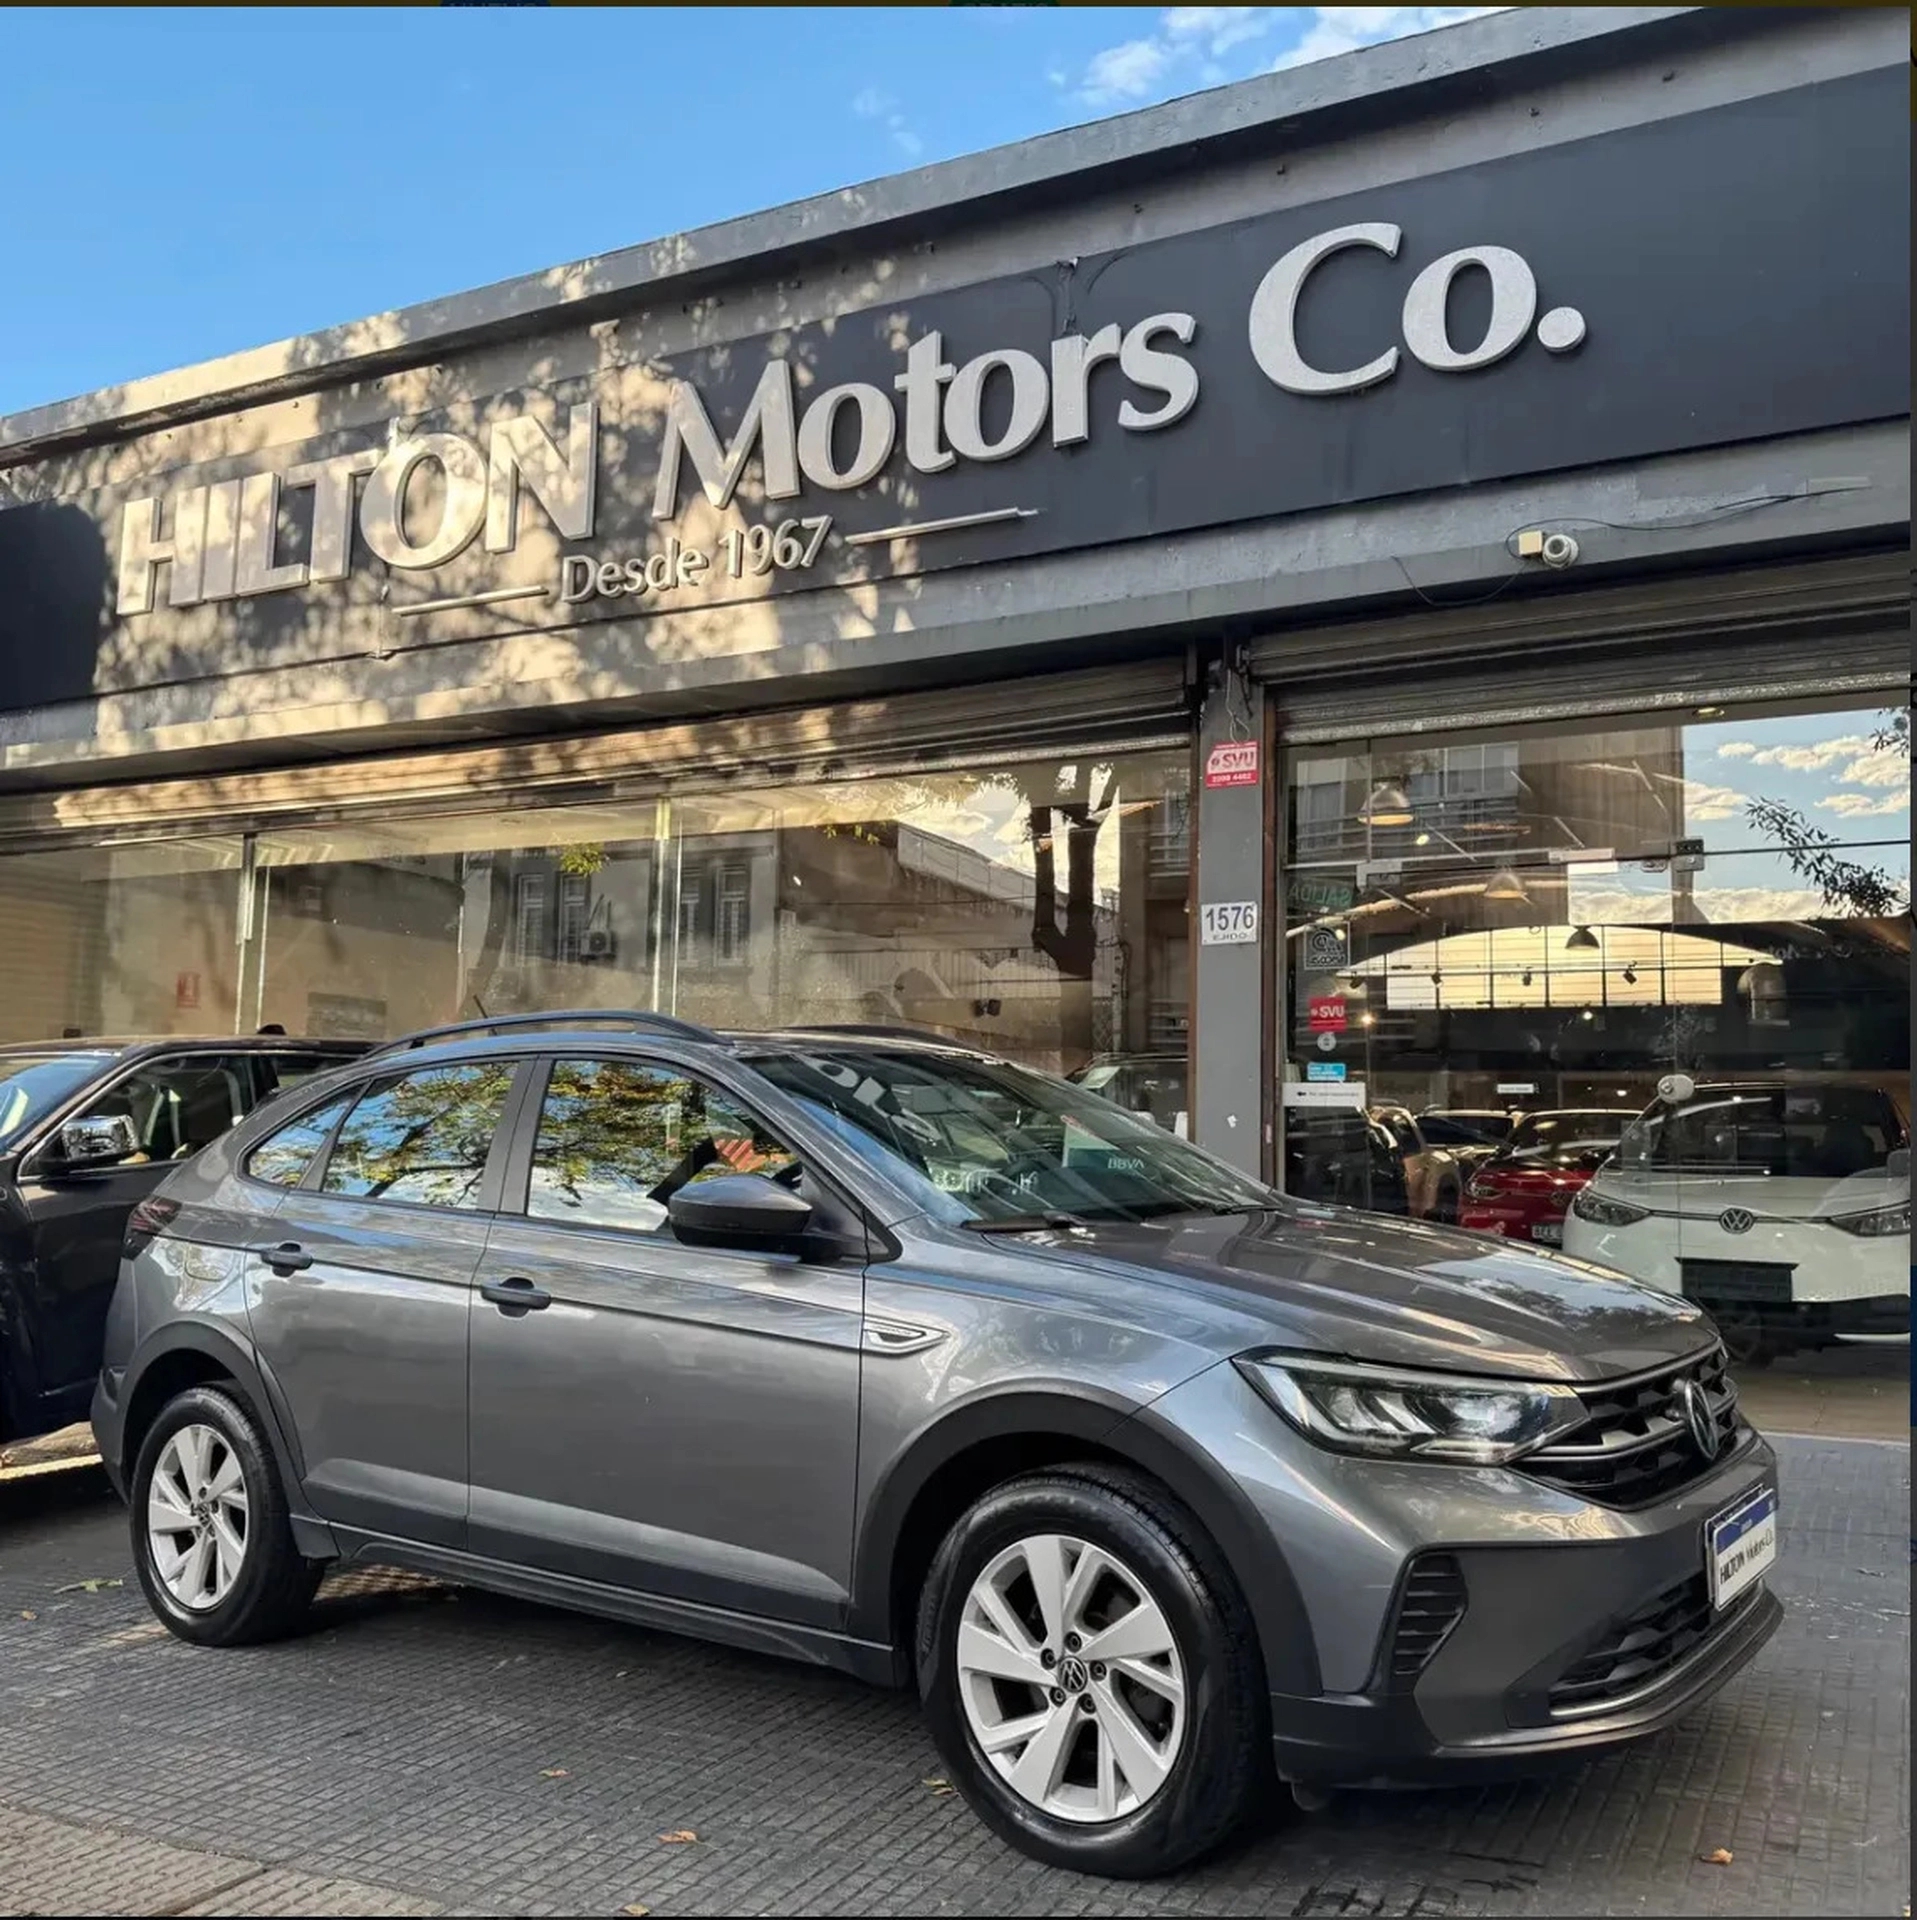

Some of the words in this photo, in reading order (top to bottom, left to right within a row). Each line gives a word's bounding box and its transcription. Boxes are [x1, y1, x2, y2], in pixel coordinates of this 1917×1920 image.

[117, 401, 598, 616] HILTON
[651, 311, 1199, 519] Motors
[1249, 222, 1586, 395] Co.
[560, 538, 708, 603] Desde
[718, 514, 833, 578] 1967
[1222, 751, 1254, 768] SVU
[1205, 905, 1254, 931] 1576
[1213, 932, 1248, 940] EJIDO
[1319, 1005, 1345, 1019] SVU
[1107, 1157, 1145, 1170] BBVA
